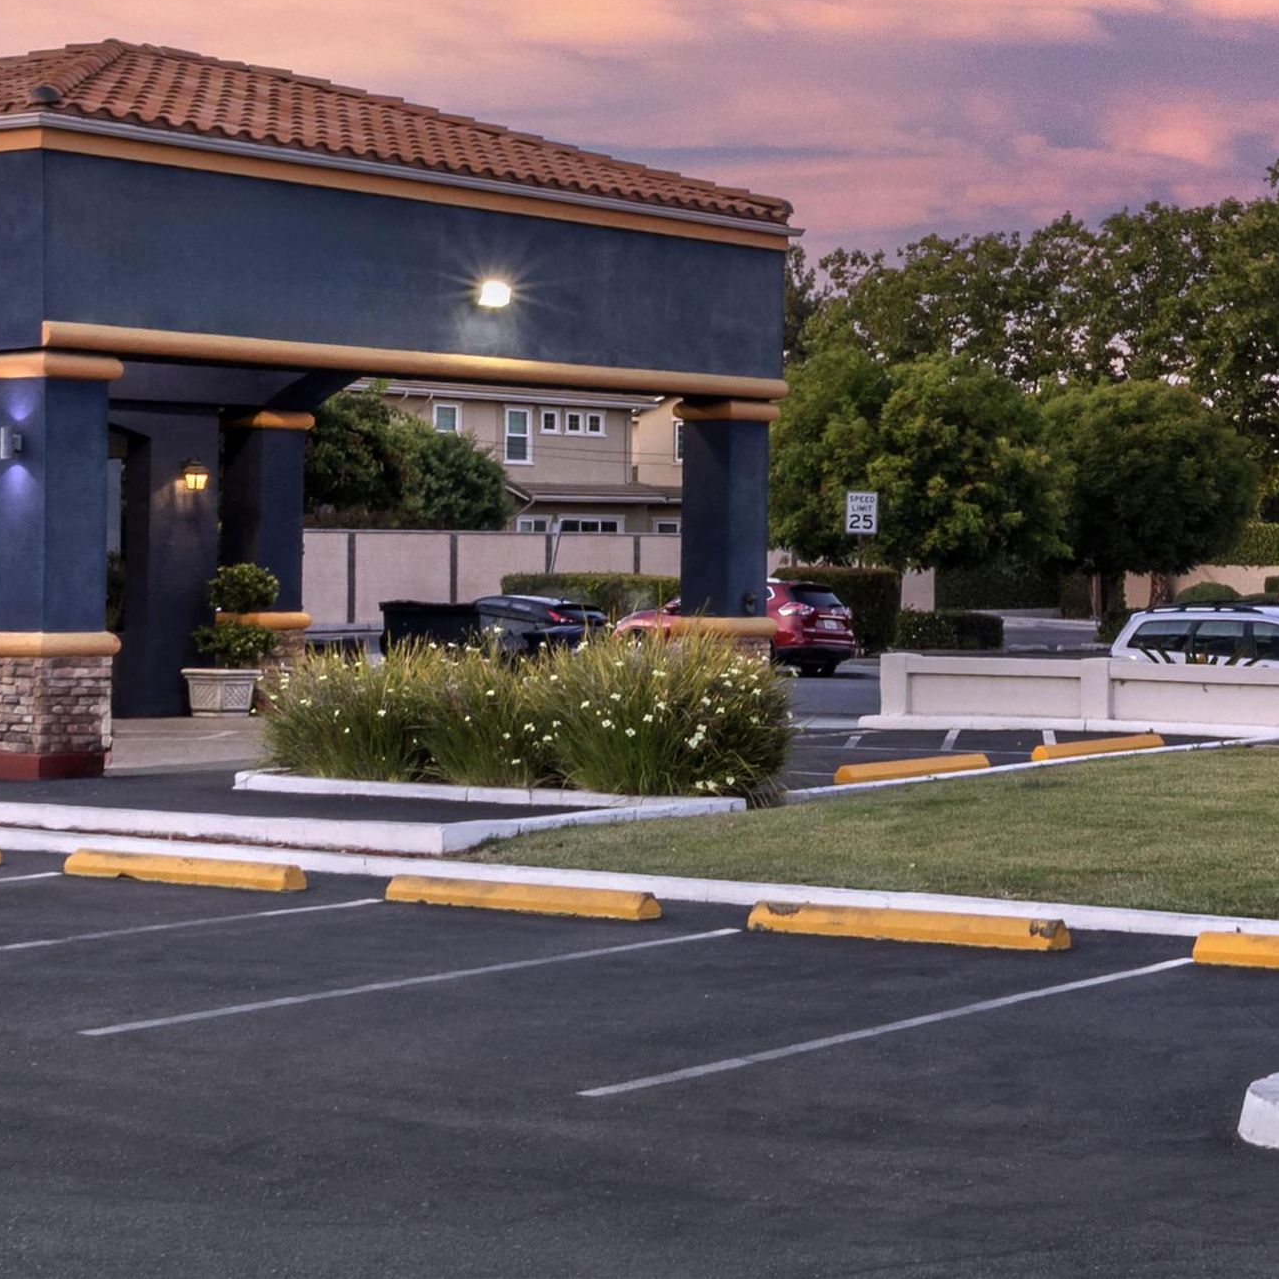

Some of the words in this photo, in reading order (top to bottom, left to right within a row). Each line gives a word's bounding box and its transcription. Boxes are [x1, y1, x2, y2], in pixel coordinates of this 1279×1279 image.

[849, 495, 875, 503] SPEED
[851, 504, 872, 512] LIMIT
[849, 514, 873, 529] 25
